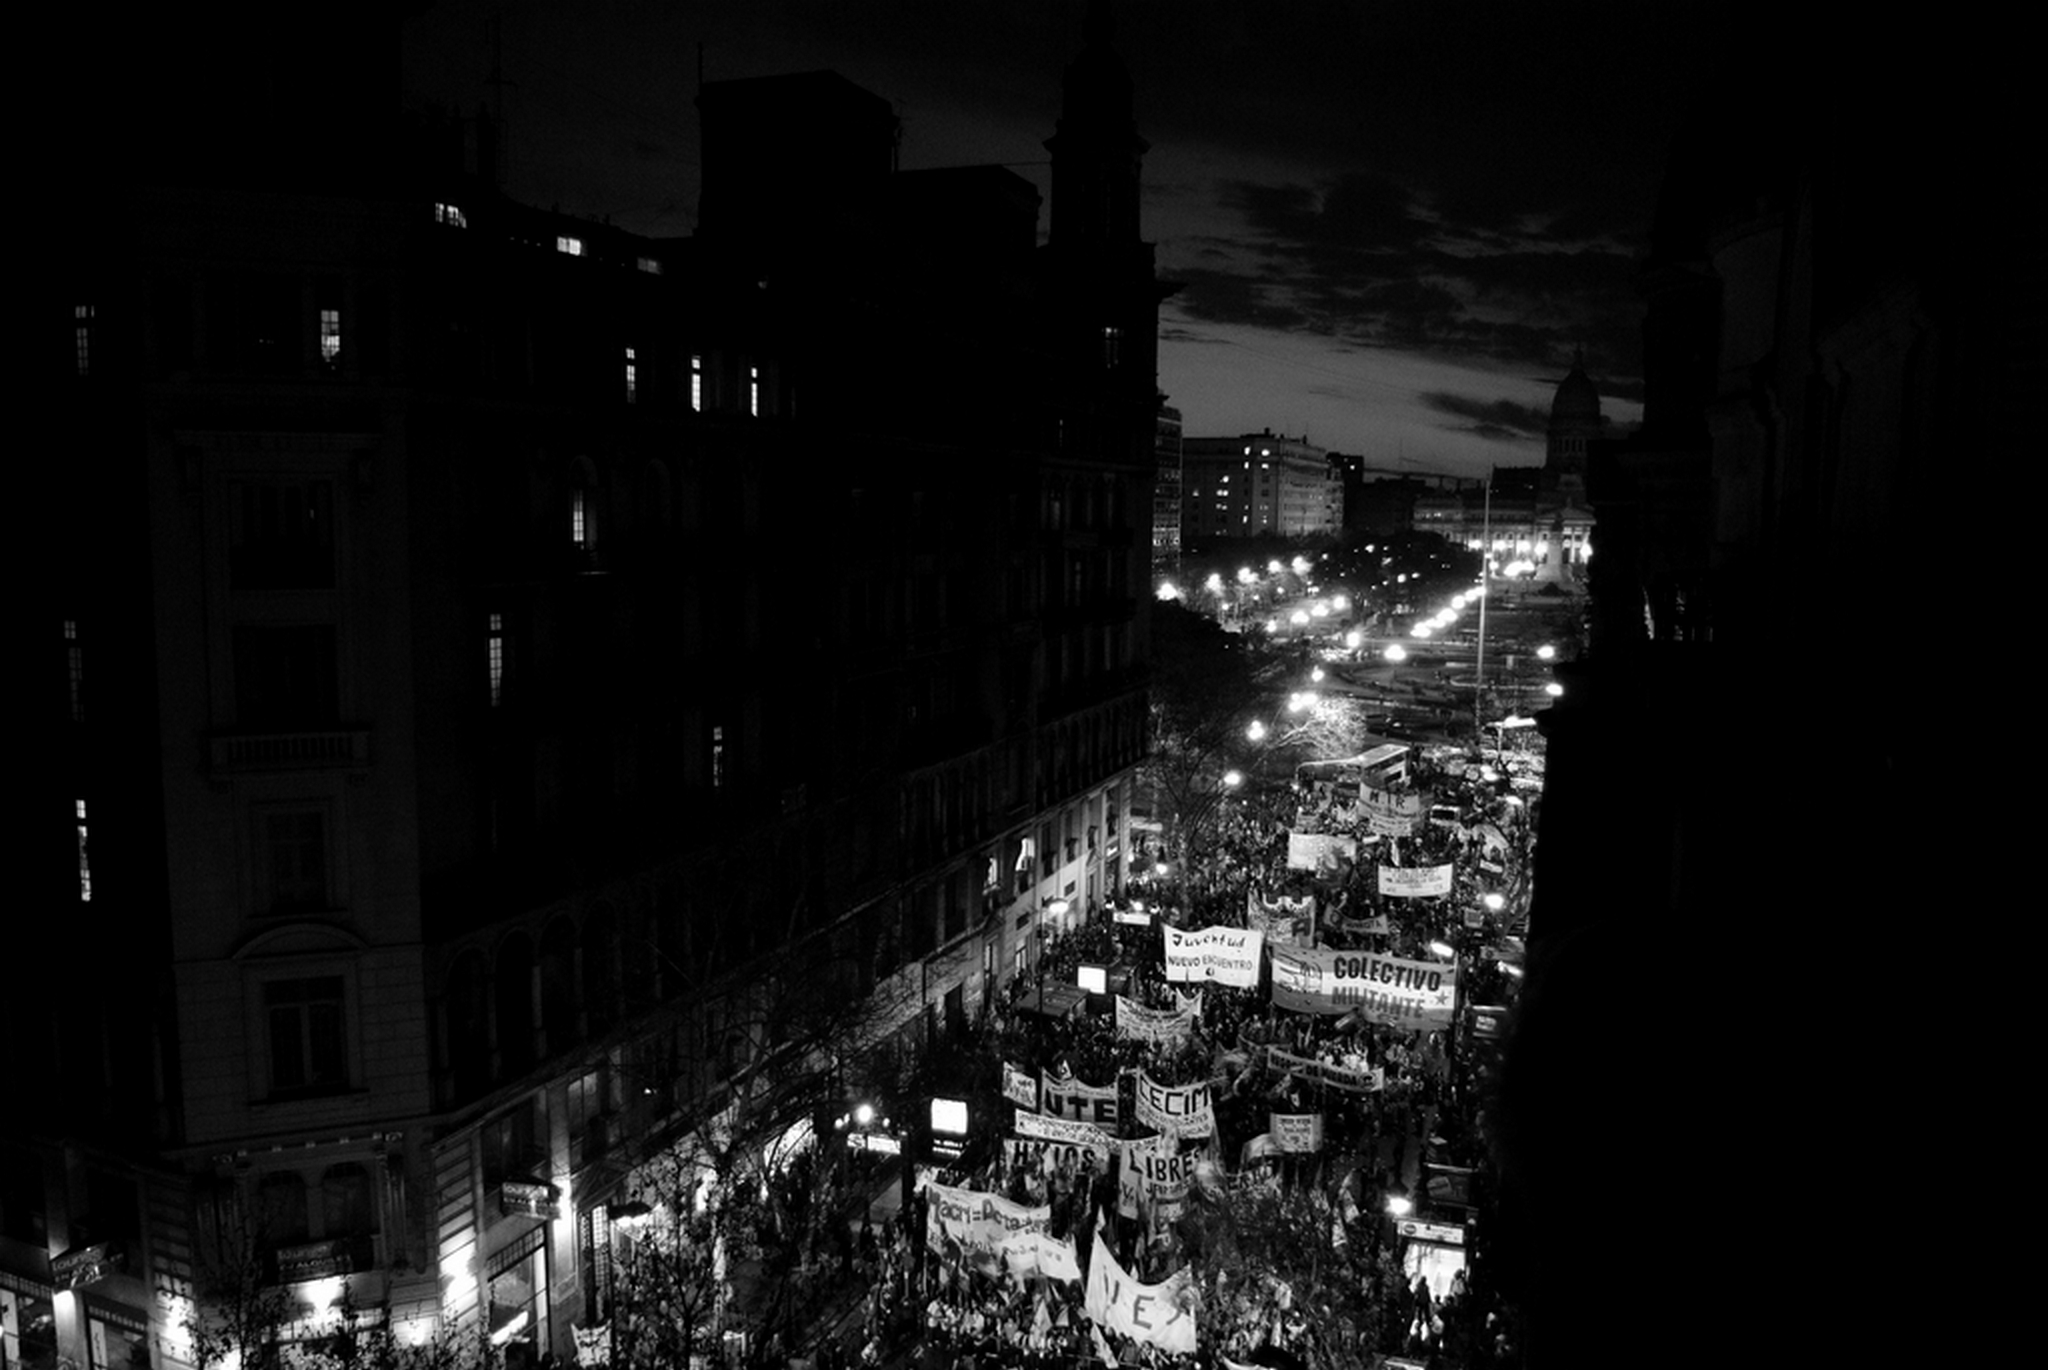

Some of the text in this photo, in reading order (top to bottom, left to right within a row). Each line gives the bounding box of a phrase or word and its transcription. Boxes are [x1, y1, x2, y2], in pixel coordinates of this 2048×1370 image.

[1168, 954, 1253, 971] NUEVO ENCUENTRO
[1334, 957, 1441, 992] COLECTIVO
[1045, 1088, 1117, 1122] UTE
